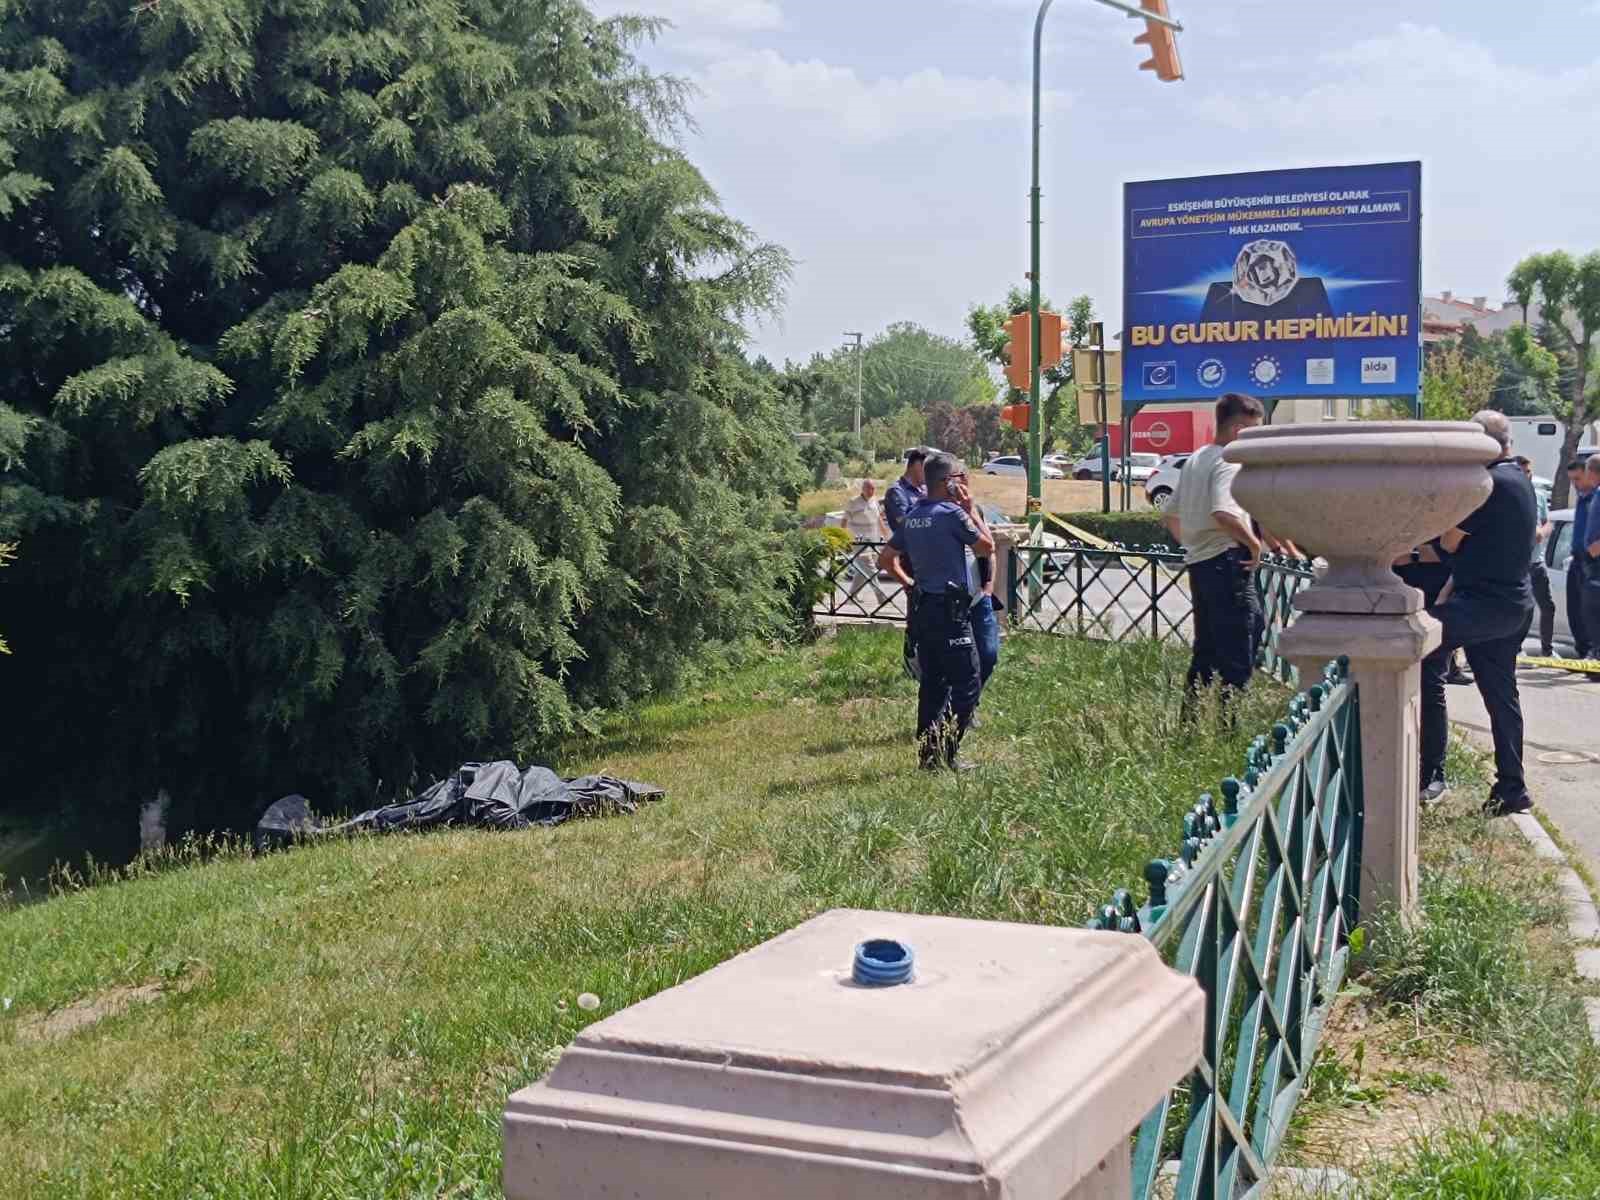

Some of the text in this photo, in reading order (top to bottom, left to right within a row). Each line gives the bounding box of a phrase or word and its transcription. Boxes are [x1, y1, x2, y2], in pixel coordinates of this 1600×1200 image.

[1168, 190, 1369, 212] ESKİŞEHİR BÜYÜKŞEHİR BELEDİYESİ OLARAK
[1140, 218, 1176, 227] AVRUPA
[1176, 213, 1225, 225] YÖNETİŞİM
[1360, 202, 1400, 213] ALMAYA
[1229, 225, 1250, 235] HAK
[1131, 311, 1408, 346] BU GURUR HEPİMİZİN!
[1363, 361, 1388, 372] alda
